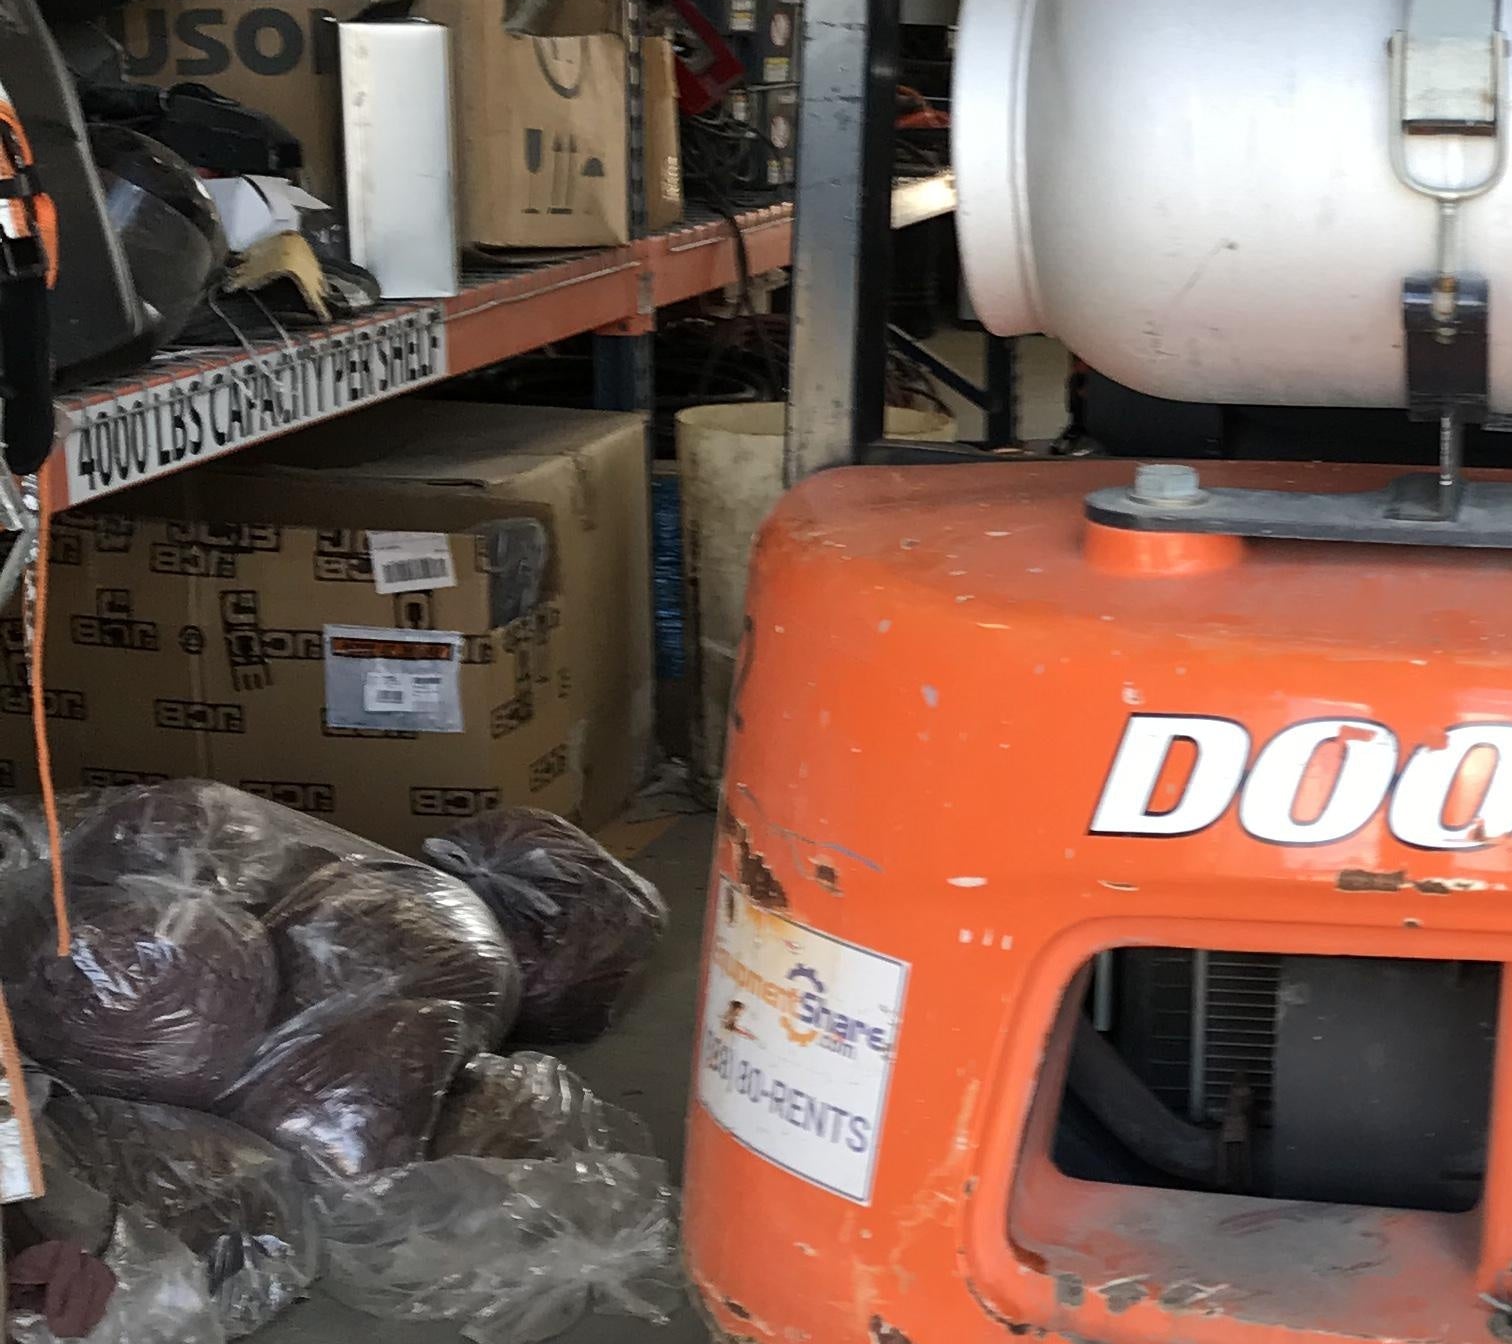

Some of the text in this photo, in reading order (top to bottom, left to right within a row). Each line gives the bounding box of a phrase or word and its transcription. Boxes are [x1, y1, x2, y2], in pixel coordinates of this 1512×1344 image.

[77, 399, 149, 491] 4000
[154, 376, 203, 466] LBS
[333, 331, 375, 407] PER
[377, 309, 442, 393] SHELF
[154, 699, 246, 734] JCB
